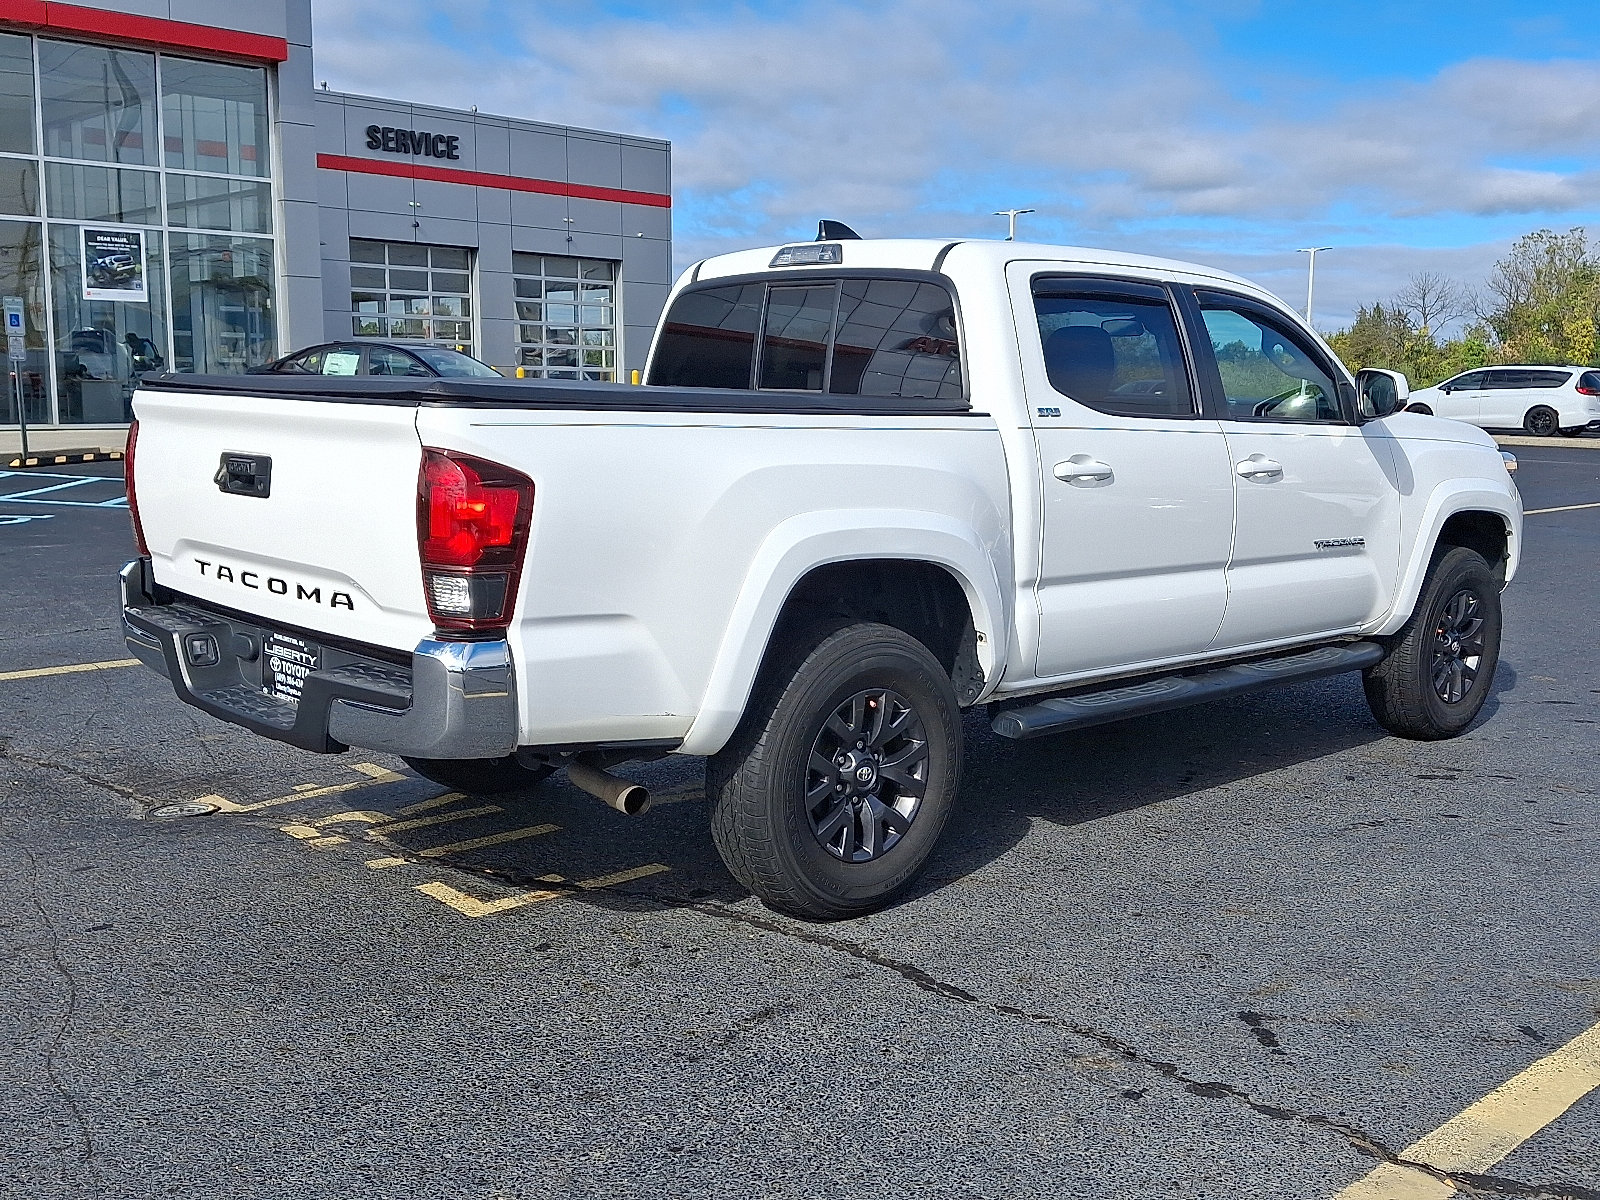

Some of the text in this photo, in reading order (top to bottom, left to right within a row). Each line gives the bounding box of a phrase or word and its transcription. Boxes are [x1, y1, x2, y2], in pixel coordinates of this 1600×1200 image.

[366, 124, 460, 160] SERVICE
[194, 558, 354, 611] TACOMA
[264, 642, 318, 666] LIBERTY
[281, 660, 310, 680] TOYOTA
[272, 690, 301, 704] LIBERT
